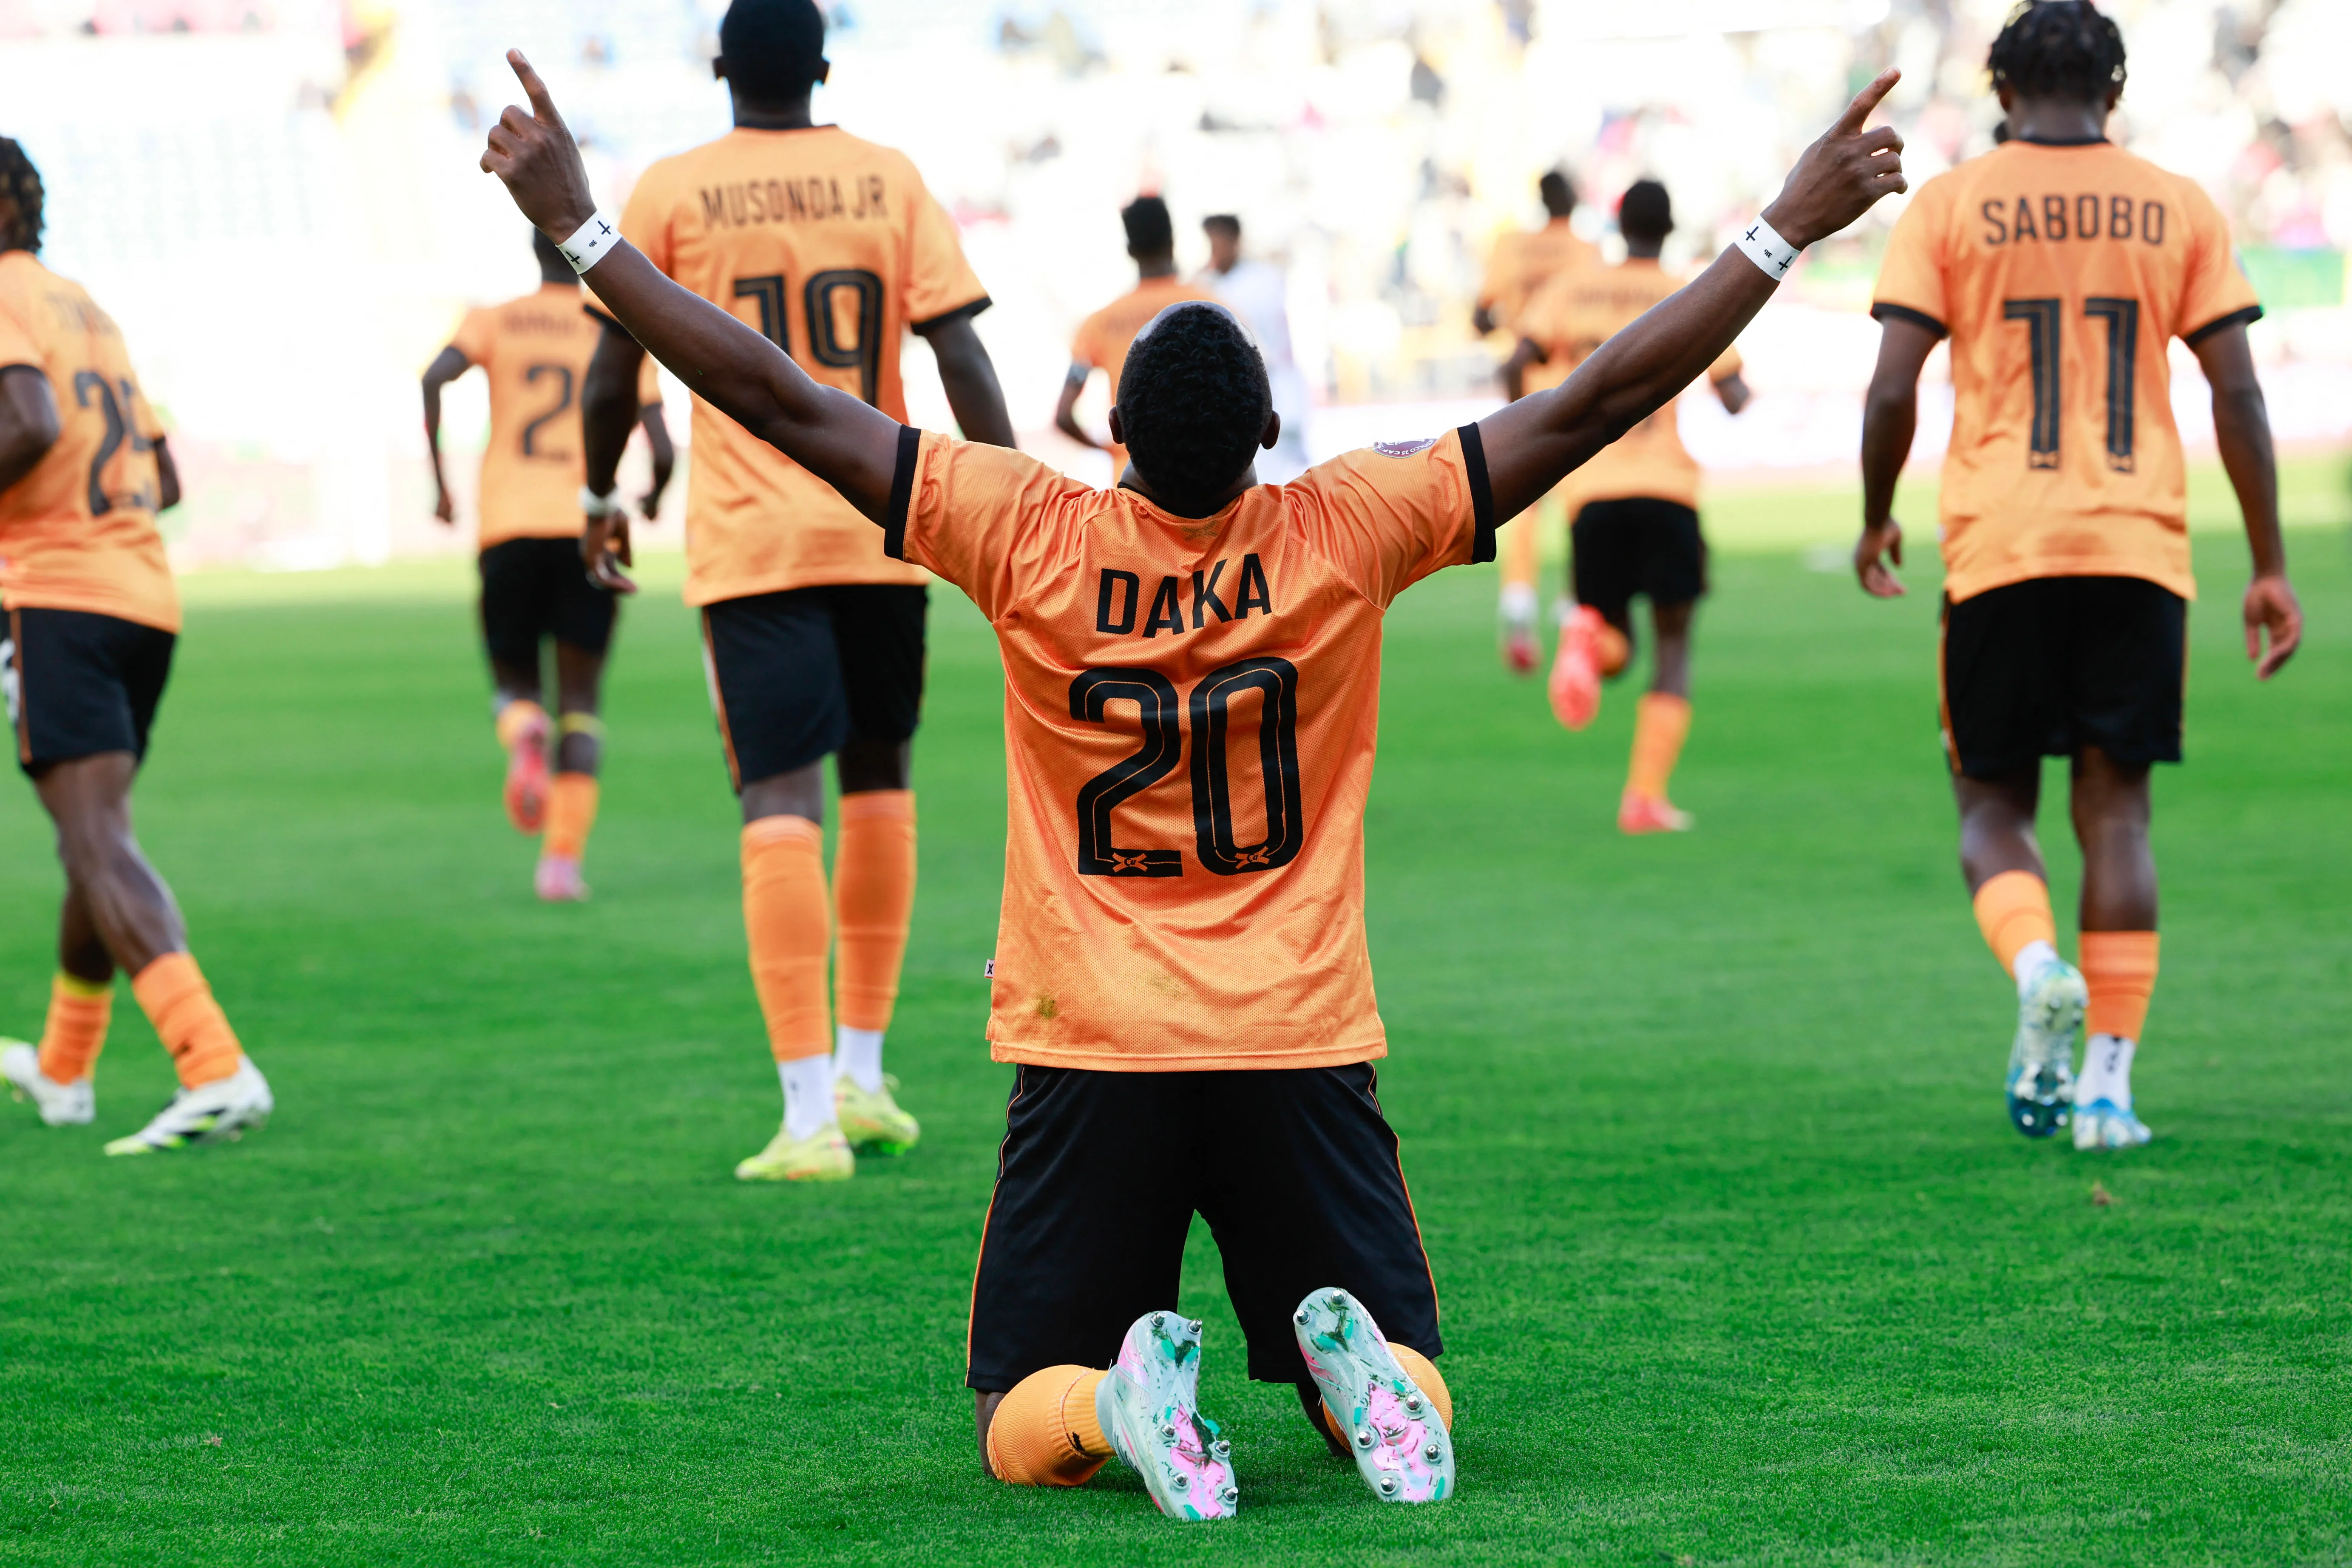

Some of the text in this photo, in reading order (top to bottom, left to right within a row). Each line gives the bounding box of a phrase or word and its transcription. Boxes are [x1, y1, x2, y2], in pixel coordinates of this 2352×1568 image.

[700, 172, 888, 232] MUSONDA JR
[1982, 194, 2165, 246] SABOBO
[733, 268, 885, 410] 19
[2003, 298, 2139, 473] 11
[525, 363, 574, 462] 2
[1096, 553, 1272, 638] DAKA
[1069, 656, 1303, 877] 20
